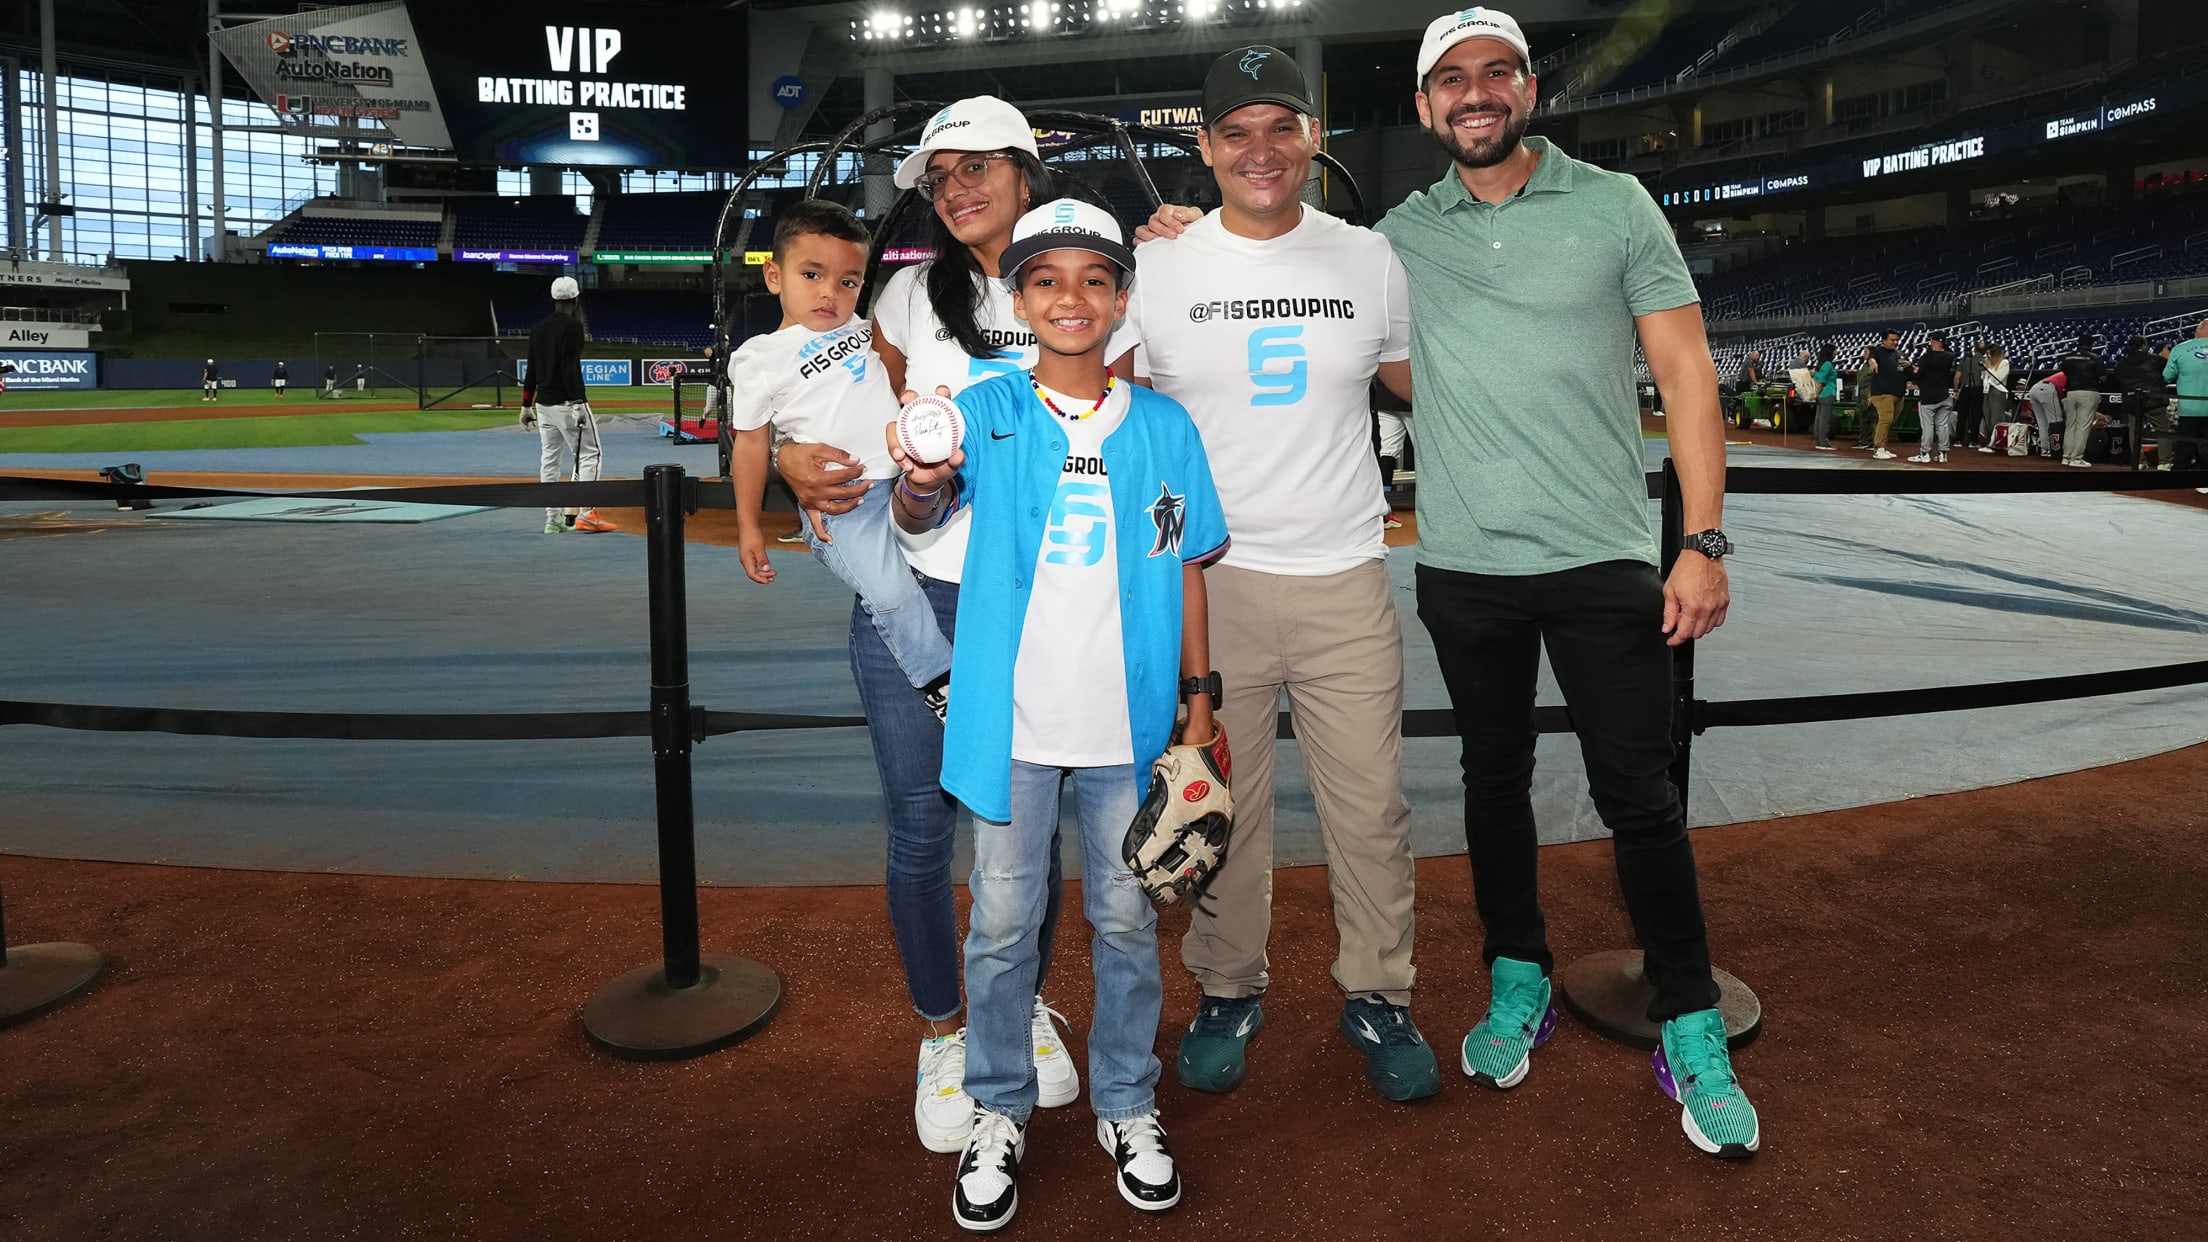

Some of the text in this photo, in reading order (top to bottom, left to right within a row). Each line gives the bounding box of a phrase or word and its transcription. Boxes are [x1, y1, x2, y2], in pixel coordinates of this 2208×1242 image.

[1457, 20, 1501, 30] GROUP
[545, 25, 622, 74] VIP
[275, 58, 391, 80] AutoNation
[478, 76, 686, 110] BATTING PRACTICE
[776, 85, 802, 98] ADT
[314, 97, 377, 108] UNIVERSITY
[394, 100, 430, 110] MIAMI
[2107, 97, 2156, 122] COMPASS
[314, 107, 398, 118] HEALTH SYSTEM
[931, 120, 971, 137] GROUP
[2059, 117, 2098, 137] TEAM SIMPKIN
[1863, 157, 1881, 178] VIP
[1883, 148, 1929, 174] BATTING
[1931, 136, 1984, 165] PRACTICE
[1767, 175, 1809, 190] COMPASS
[1730, 187, 1759, 198] SIMPKIN
[271, 246, 319, 256] AutoNation
[462, 251, 501, 260] loanDepot
[1189, 298, 1355, 323] @FISGROUPINC
[9, 329, 49, 345] Alley
[799, 353, 832, 379] FIS
[586, 373, 611, 381] LINE
